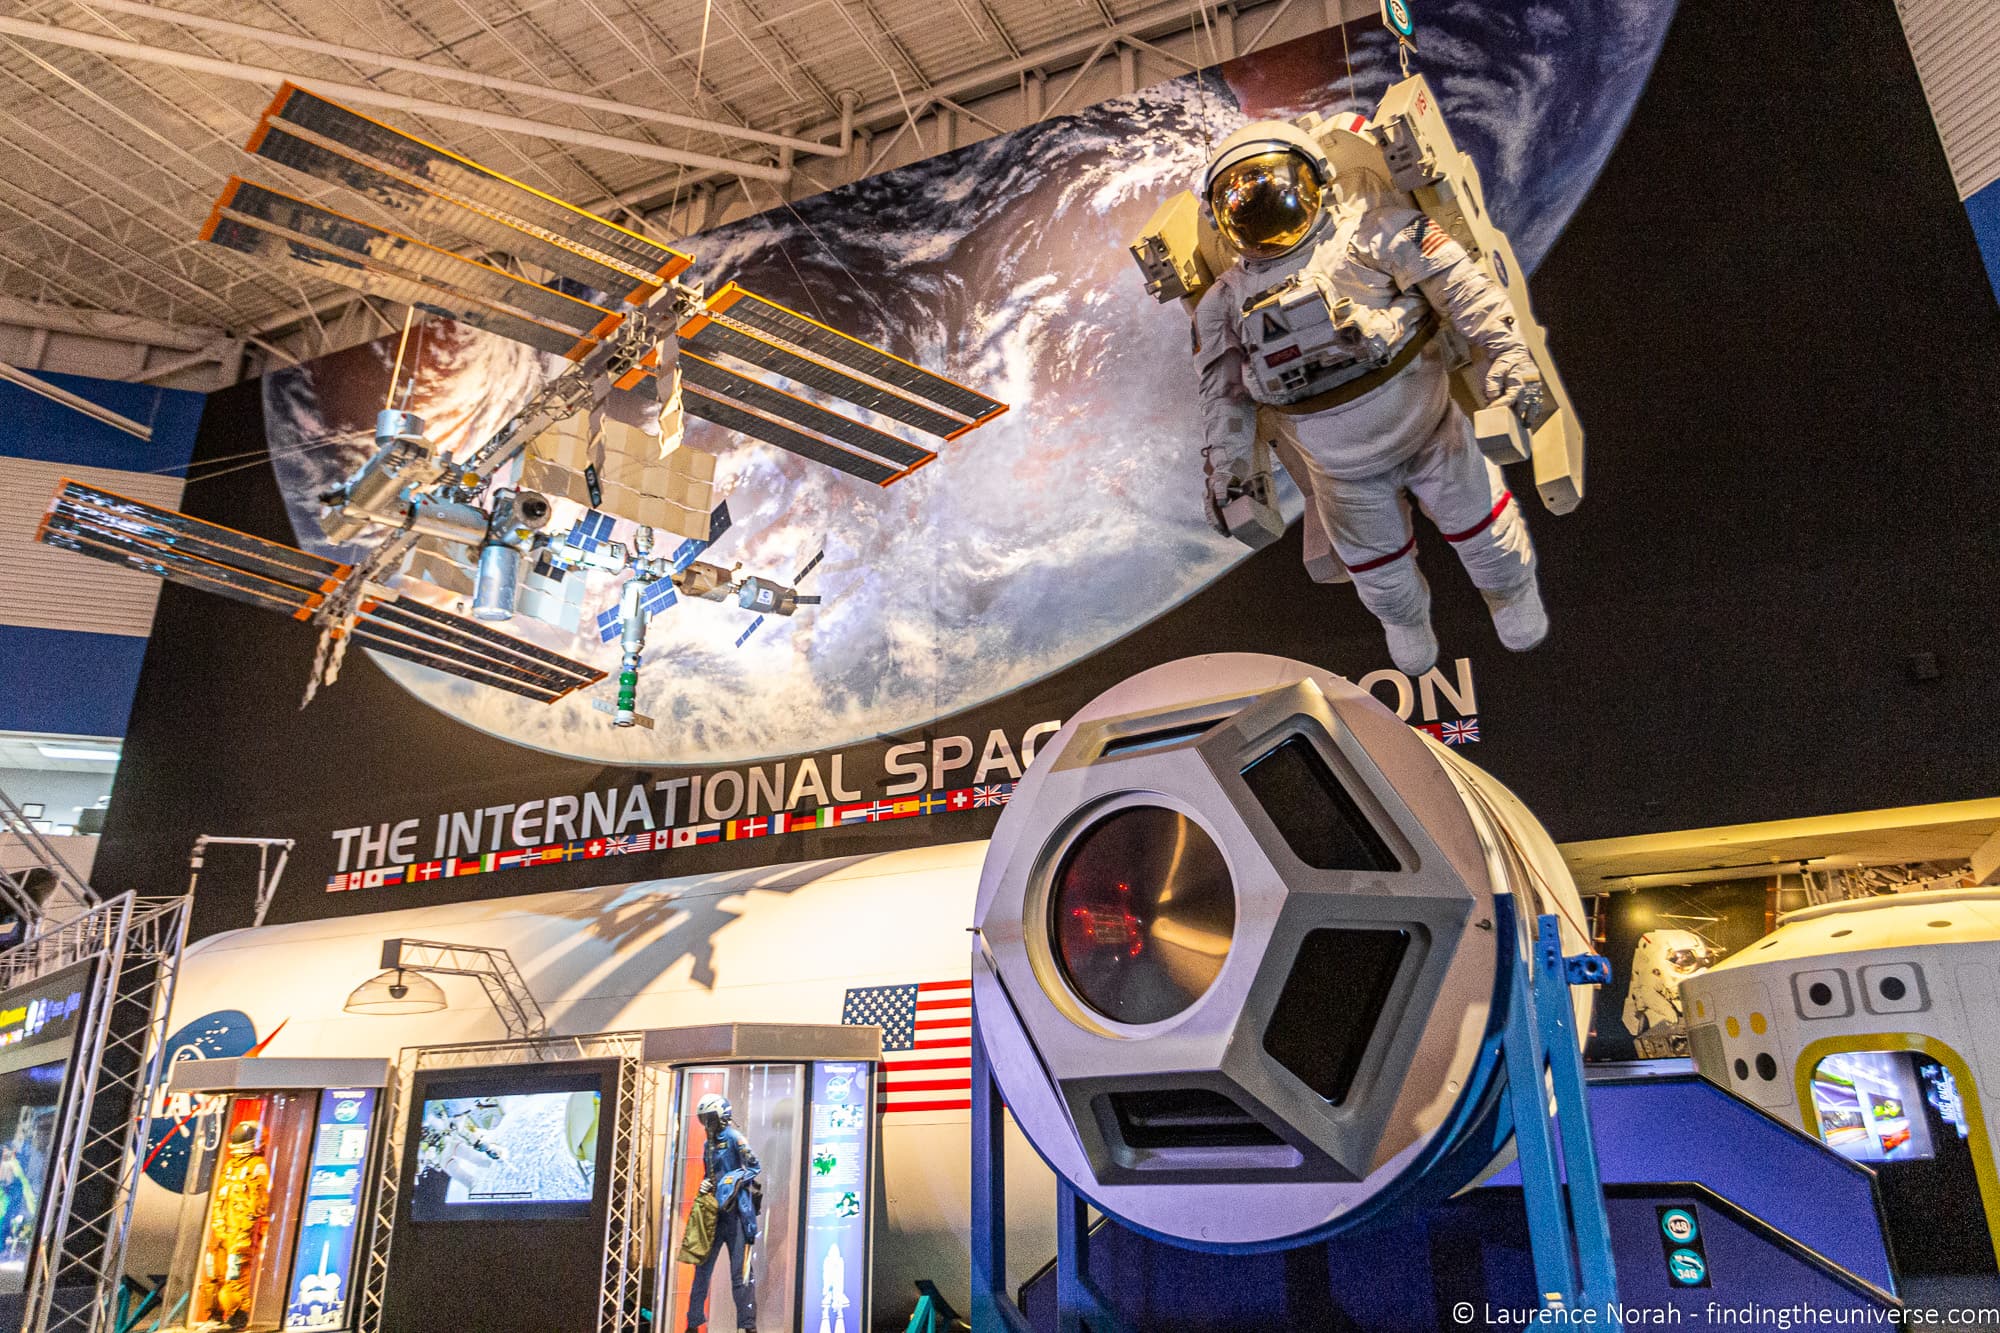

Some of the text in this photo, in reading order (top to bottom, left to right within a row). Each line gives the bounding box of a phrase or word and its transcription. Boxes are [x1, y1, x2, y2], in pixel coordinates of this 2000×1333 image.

[332, 818, 420, 872] THE
[433, 753, 862, 859] INTERNATIONAL
[884, 719, 1062, 797] SPAC
